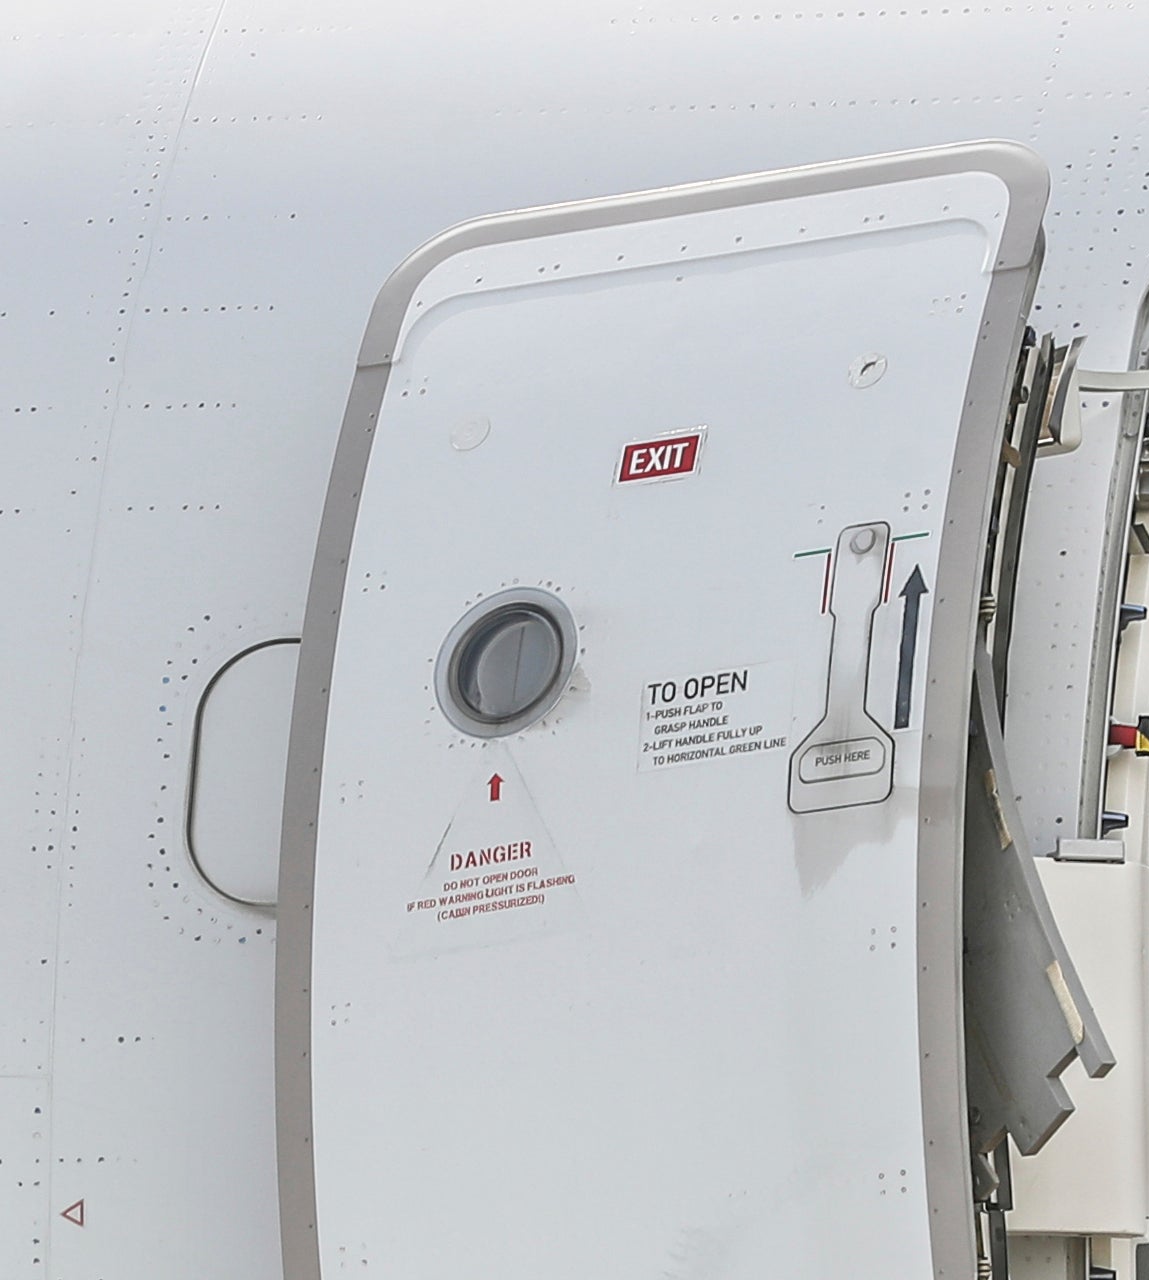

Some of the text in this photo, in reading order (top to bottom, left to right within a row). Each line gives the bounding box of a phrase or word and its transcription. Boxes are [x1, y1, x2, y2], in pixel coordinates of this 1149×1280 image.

[629, 442, 690, 475] EXIT
[648, 670, 748, 705] TO OPEN
[646, 701, 723, 721] 1-PUSH FLAP TO
[654, 715, 729, 735] GRASP HANDLE
[643, 725, 763, 752] 2-LIFT HANDLE FULLY UP
[653, 737, 787, 766] TO HORIZONTAL GREEN LINE
[815, 750, 871, 767] PUSH HERE
[450, 841, 532, 871] DANGER
[444, 867, 538, 891] DO NOT OPEN DOOR
[407, 875, 575, 912] IF RED WARNING LIGHT IS FLASHING
